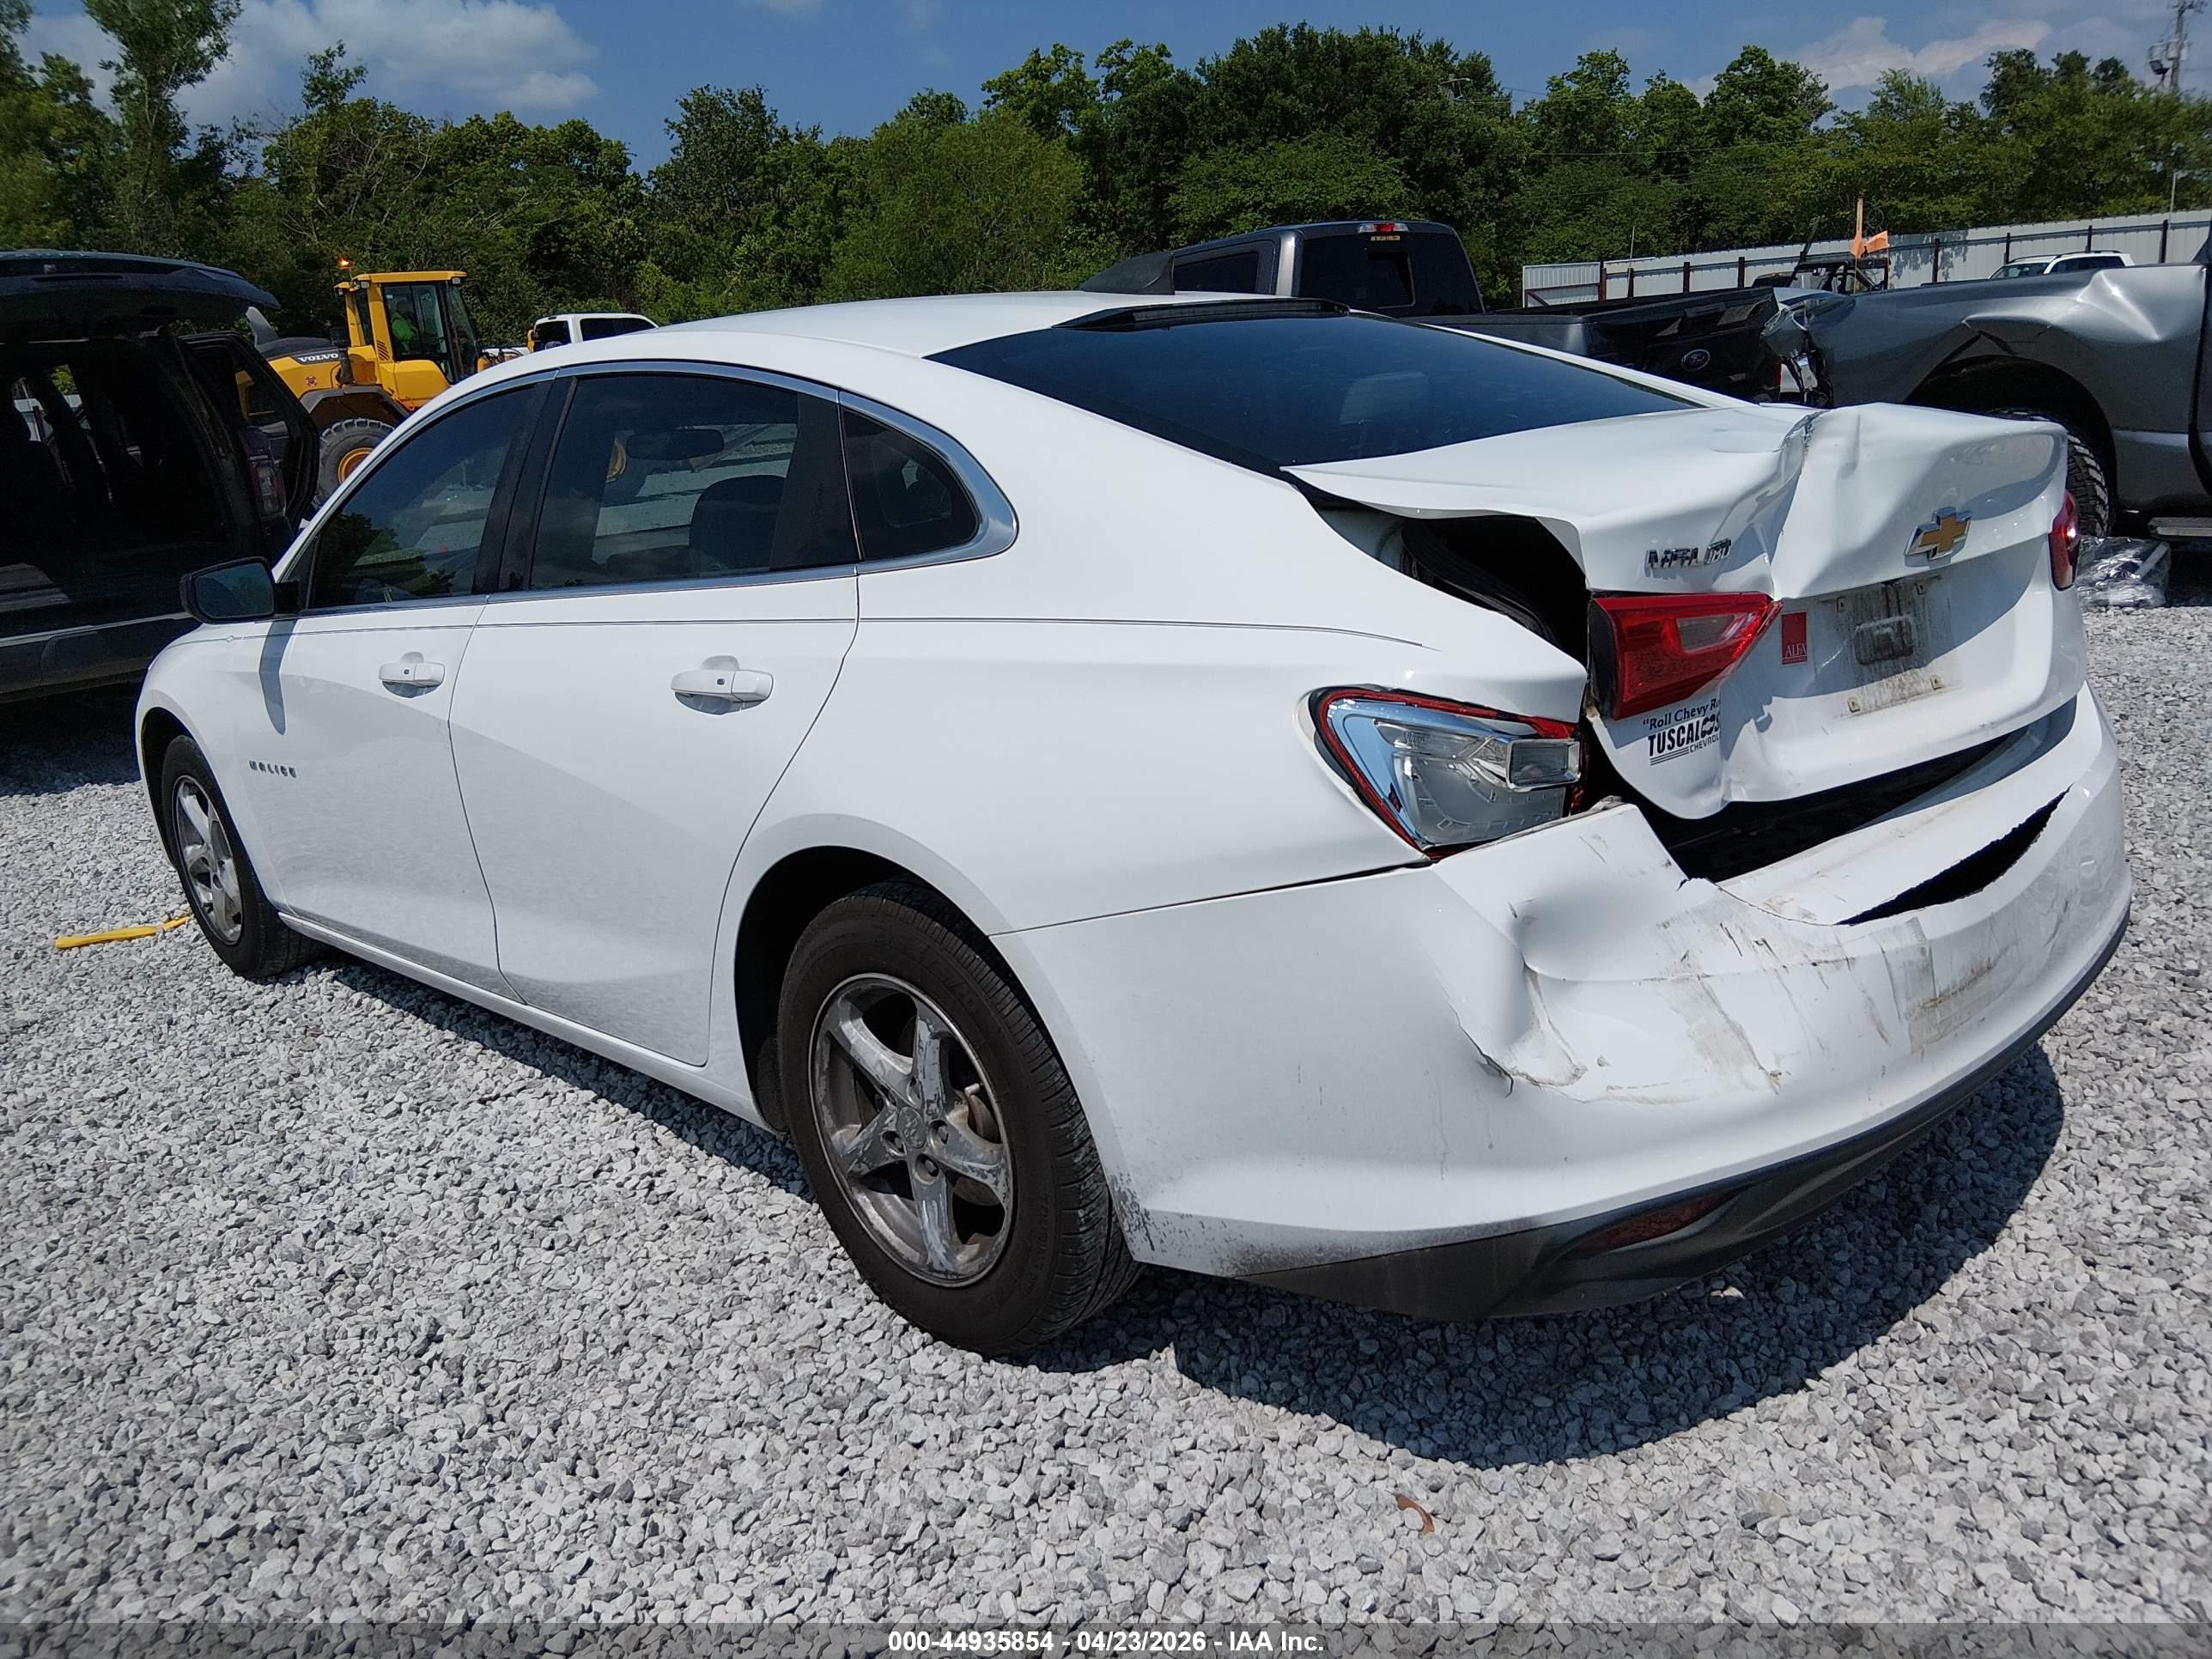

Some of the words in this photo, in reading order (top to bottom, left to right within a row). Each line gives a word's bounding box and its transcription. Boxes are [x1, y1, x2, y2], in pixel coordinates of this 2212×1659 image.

[298, 353, 339, 362] VOLVO
[1785, 643, 1807, 658] ALFA
[1674, 704, 1709, 722] Chevy
